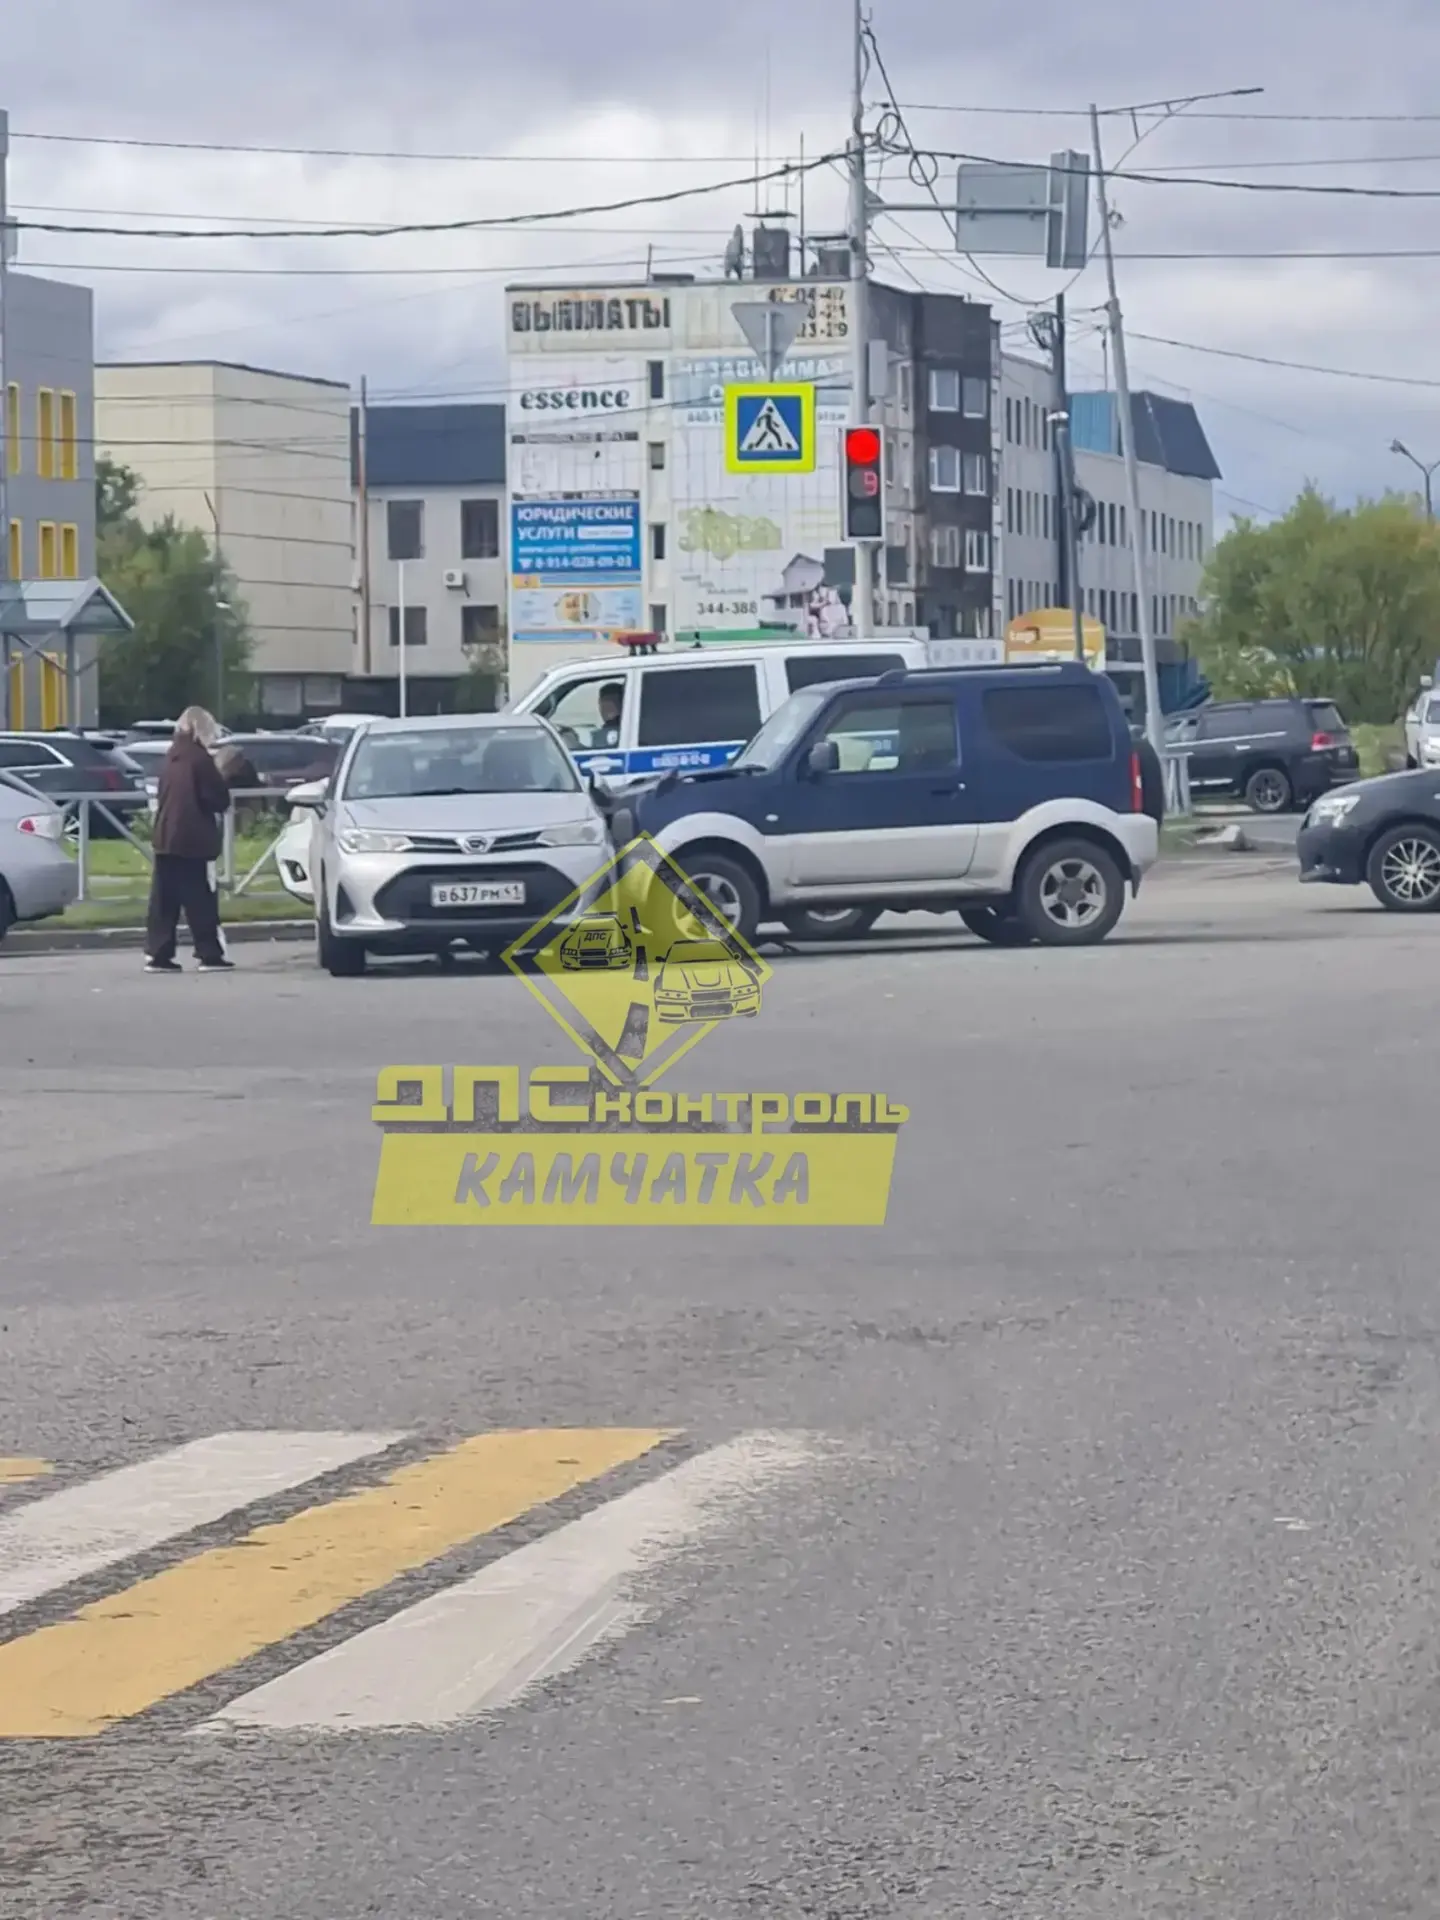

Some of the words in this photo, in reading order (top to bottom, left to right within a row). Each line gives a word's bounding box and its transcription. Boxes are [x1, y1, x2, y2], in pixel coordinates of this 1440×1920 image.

[679, 359, 844, 378] НЕЗАВИИМАЯ
[520, 389, 630, 410] essence
[517, 505, 634, 522] ЮРИДИЧЕСКИЕ
[517, 525, 575, 540] УСЛУГИ
[697, 600, 757, 615] 344-388
